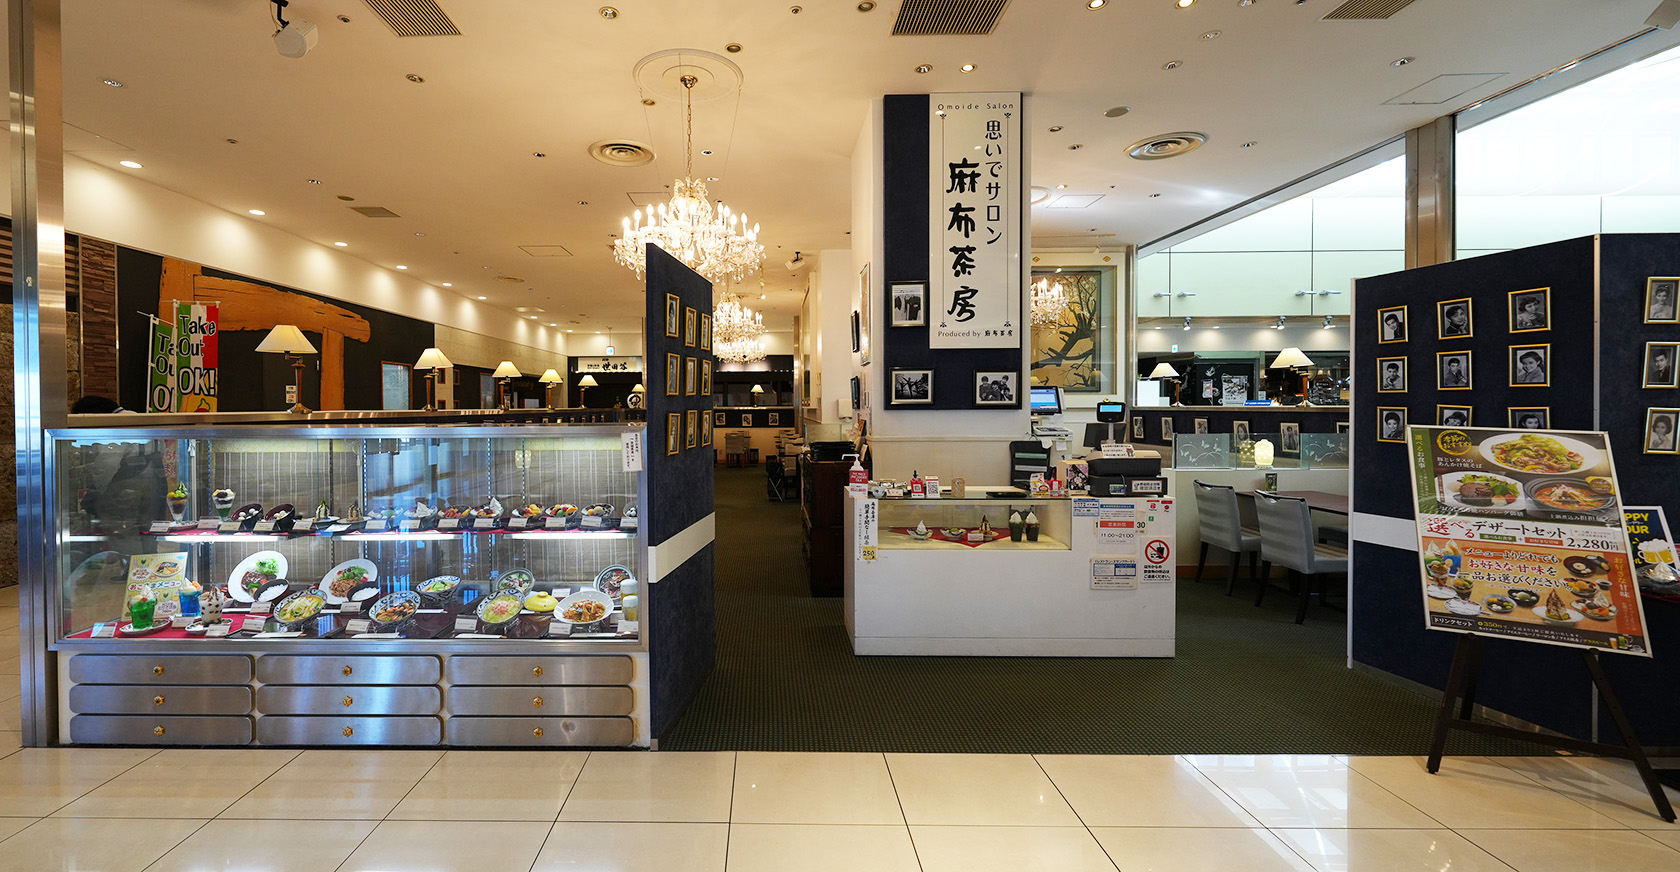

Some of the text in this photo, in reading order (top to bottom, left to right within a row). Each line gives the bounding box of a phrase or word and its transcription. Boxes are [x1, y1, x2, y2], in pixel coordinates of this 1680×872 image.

[937, 102, 1014, 111] Omoide Salon
[984, 120, 1003, 245] 思いでサロン
[945, 157, 982, 322] 麻布茶房
[179, 314, 217, 335] Take
[937, 329, 1013, 339] Produced by 麻布茶房
[179, 337, 206, 357] Out
[178, 367, 217, 396] OK!
[1624, 512, 1649, 522] PPY
[1427, 517, 1567, 539] 選べるデザートセット
[1465, 547, 1559, 563] メニューよりどれでも
[1468, 559, 1558, 576] お好きな甘味を
[1433, 617, 1473, 627] ドリンクセット
